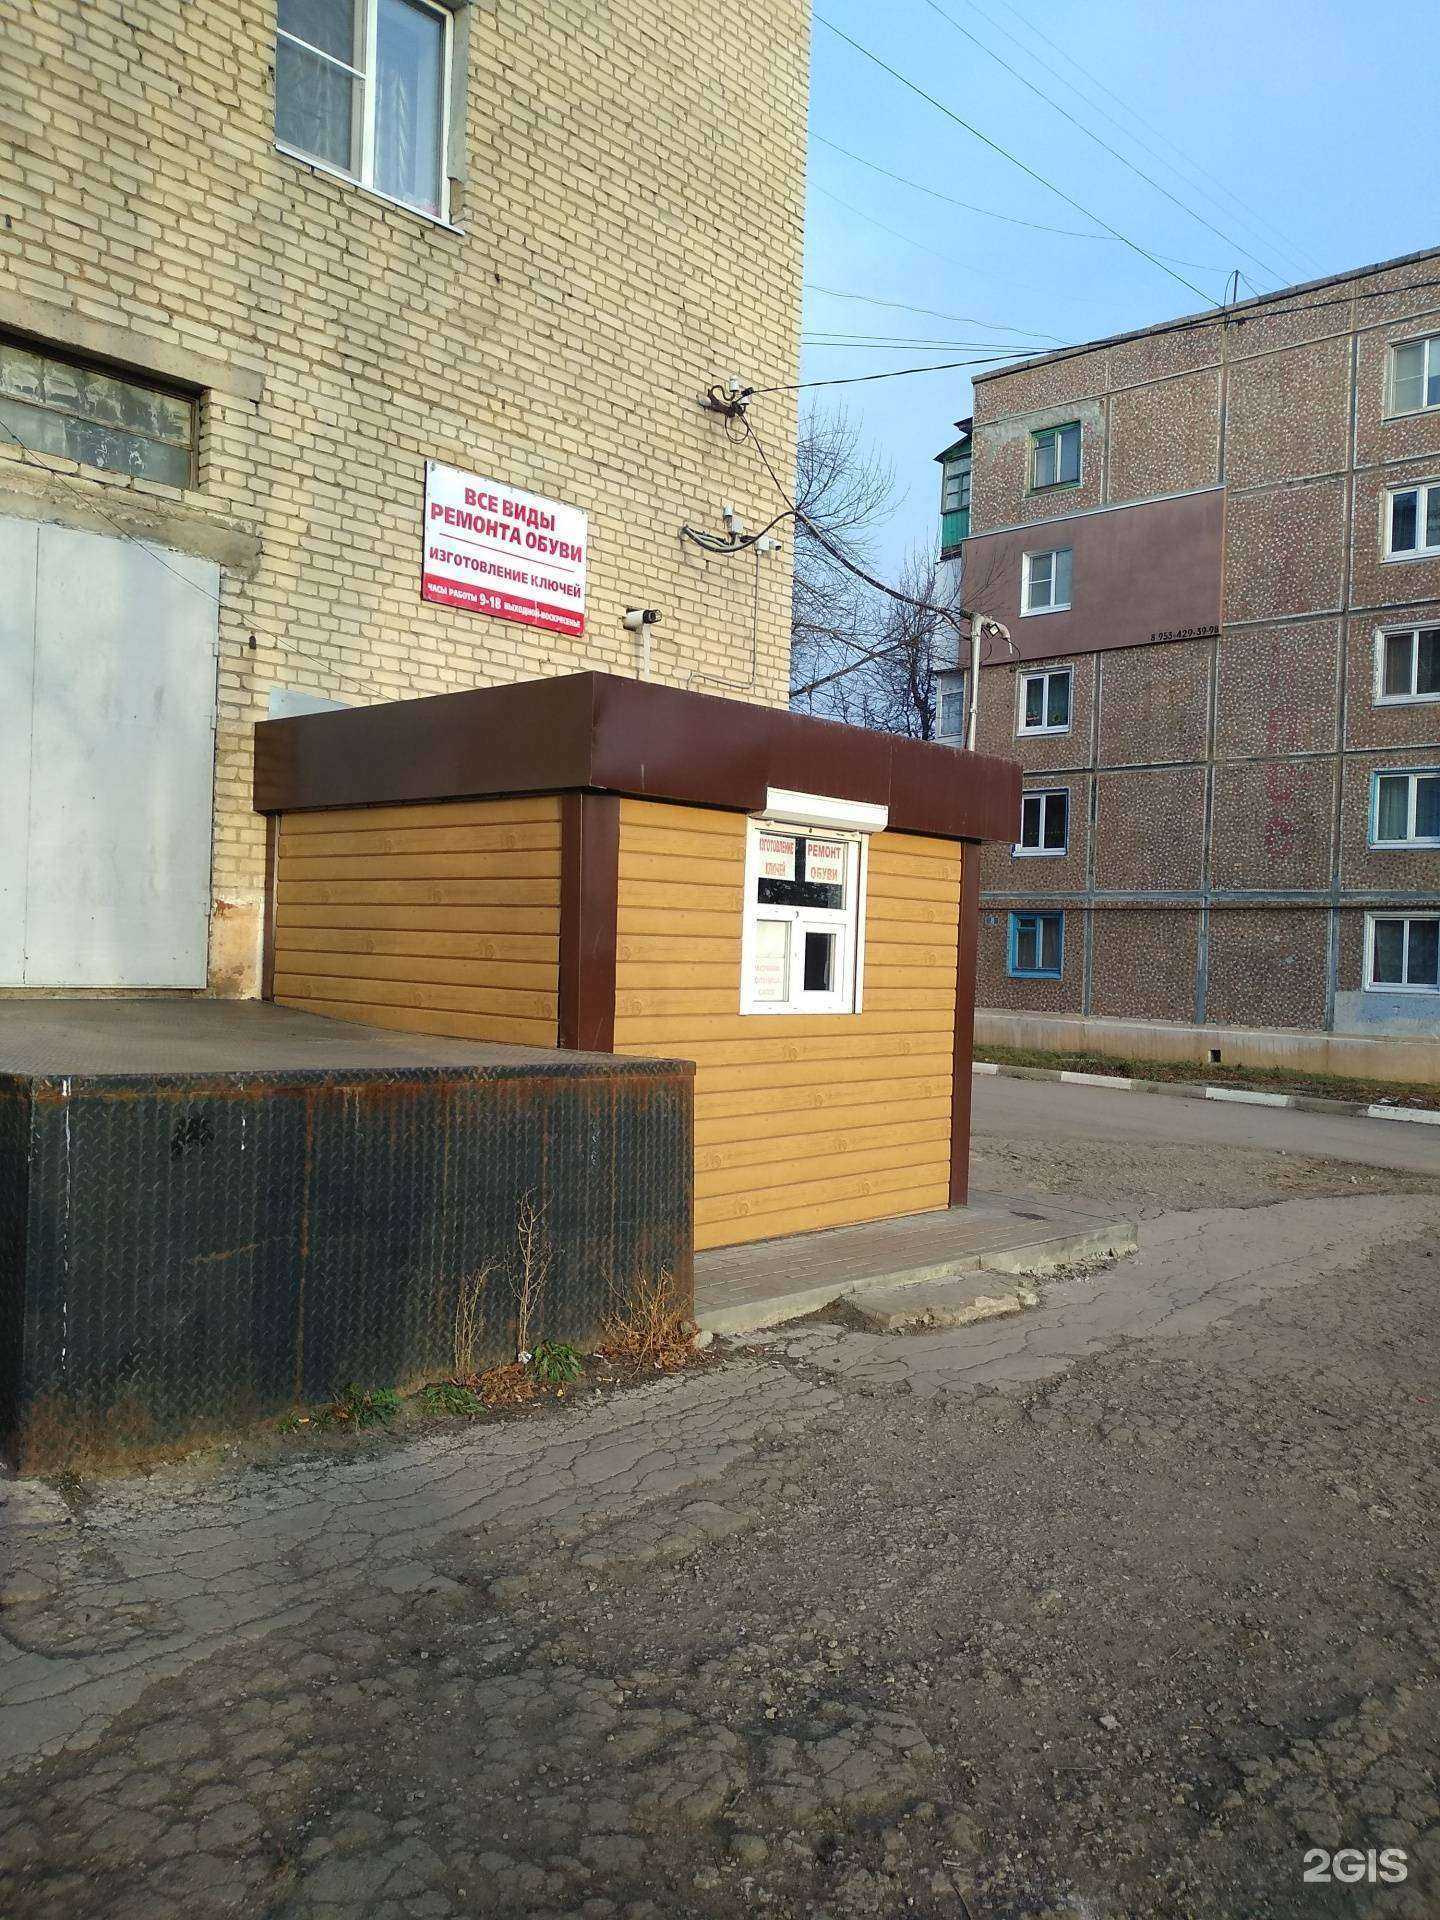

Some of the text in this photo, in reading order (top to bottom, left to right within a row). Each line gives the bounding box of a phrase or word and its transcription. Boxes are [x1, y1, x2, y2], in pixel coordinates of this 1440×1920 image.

[464, 487, 555, 532] ВСЕ ВИДЫ
[430, 502, 583, 563] РЕМОНТА ОБУВИ
[429, 546, 582, 599] ИЗГОТОВЛЕНИЕ КЛЮЧЕЙ
[427, 583, 448, 595] ЧАСЫ
[448, 587, 478, 602] РАБОТЫ
[479, 592, 502, 610] 9-18
[808, 844, 841, 859] РЕМОНТ
[810, 866, 838, 881] ОБУВИ
